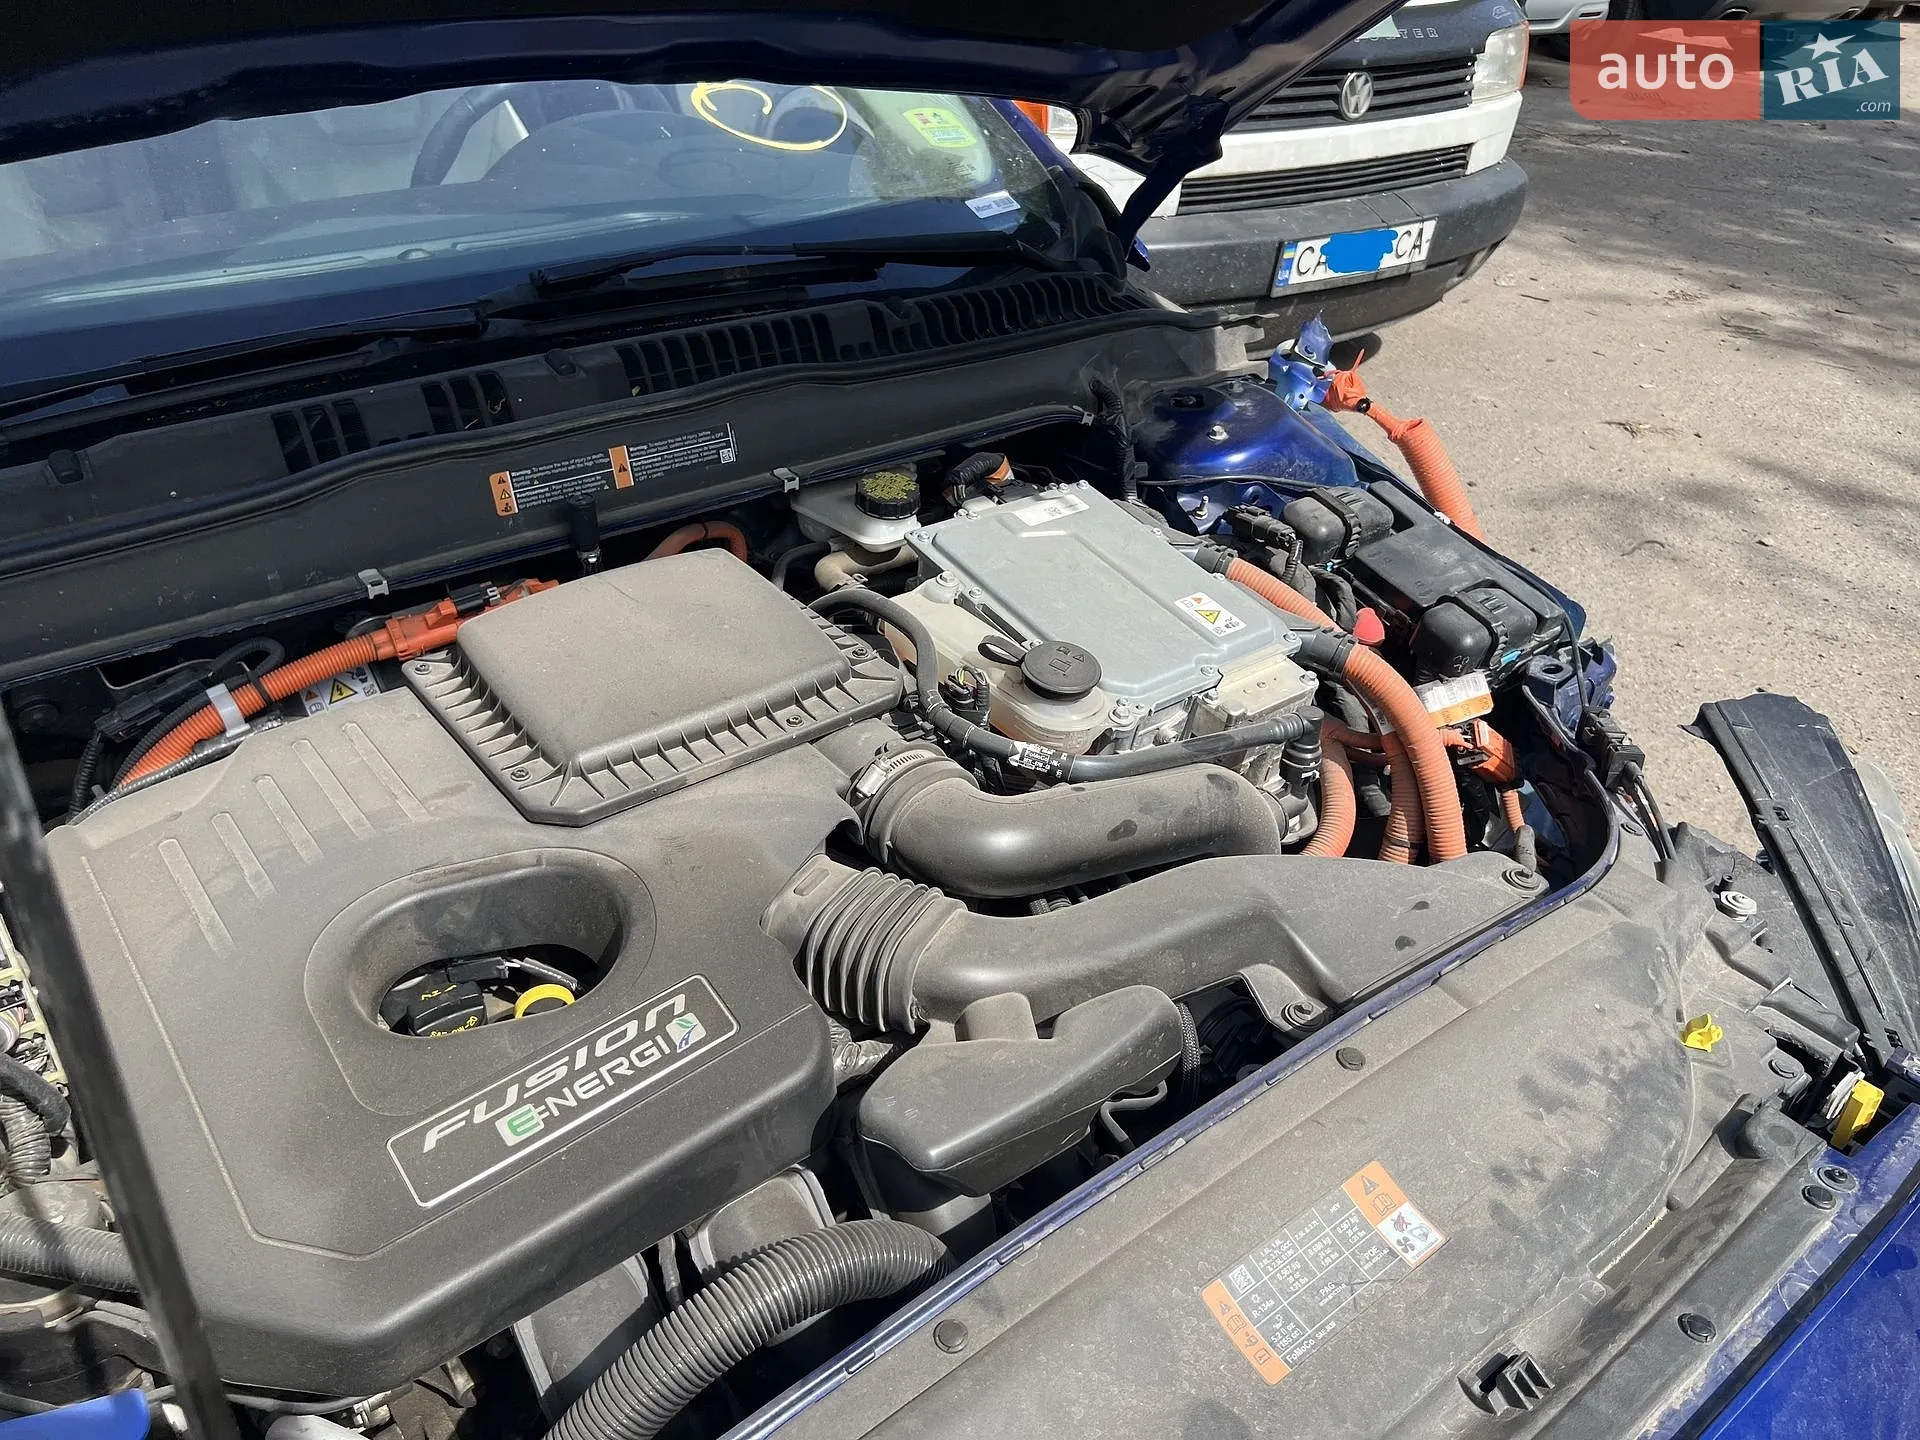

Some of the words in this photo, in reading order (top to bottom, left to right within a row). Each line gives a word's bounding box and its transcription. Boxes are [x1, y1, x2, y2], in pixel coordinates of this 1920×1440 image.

[423, 993, 686, 1153] FUSION
[1363, 1245, 1380, 1260] POE
[1319, 1282, 1335, 1297] PAG
[1252, 1299, 1275, 1318] R-134a
[1271, 1331, 1283, 1343] 5.2
[1286, 1322, 1296, 1331] oz
[1291, 1328, 1303, 1339] cc)
[1286, 1339, 1316, 1364] FoMoCo
